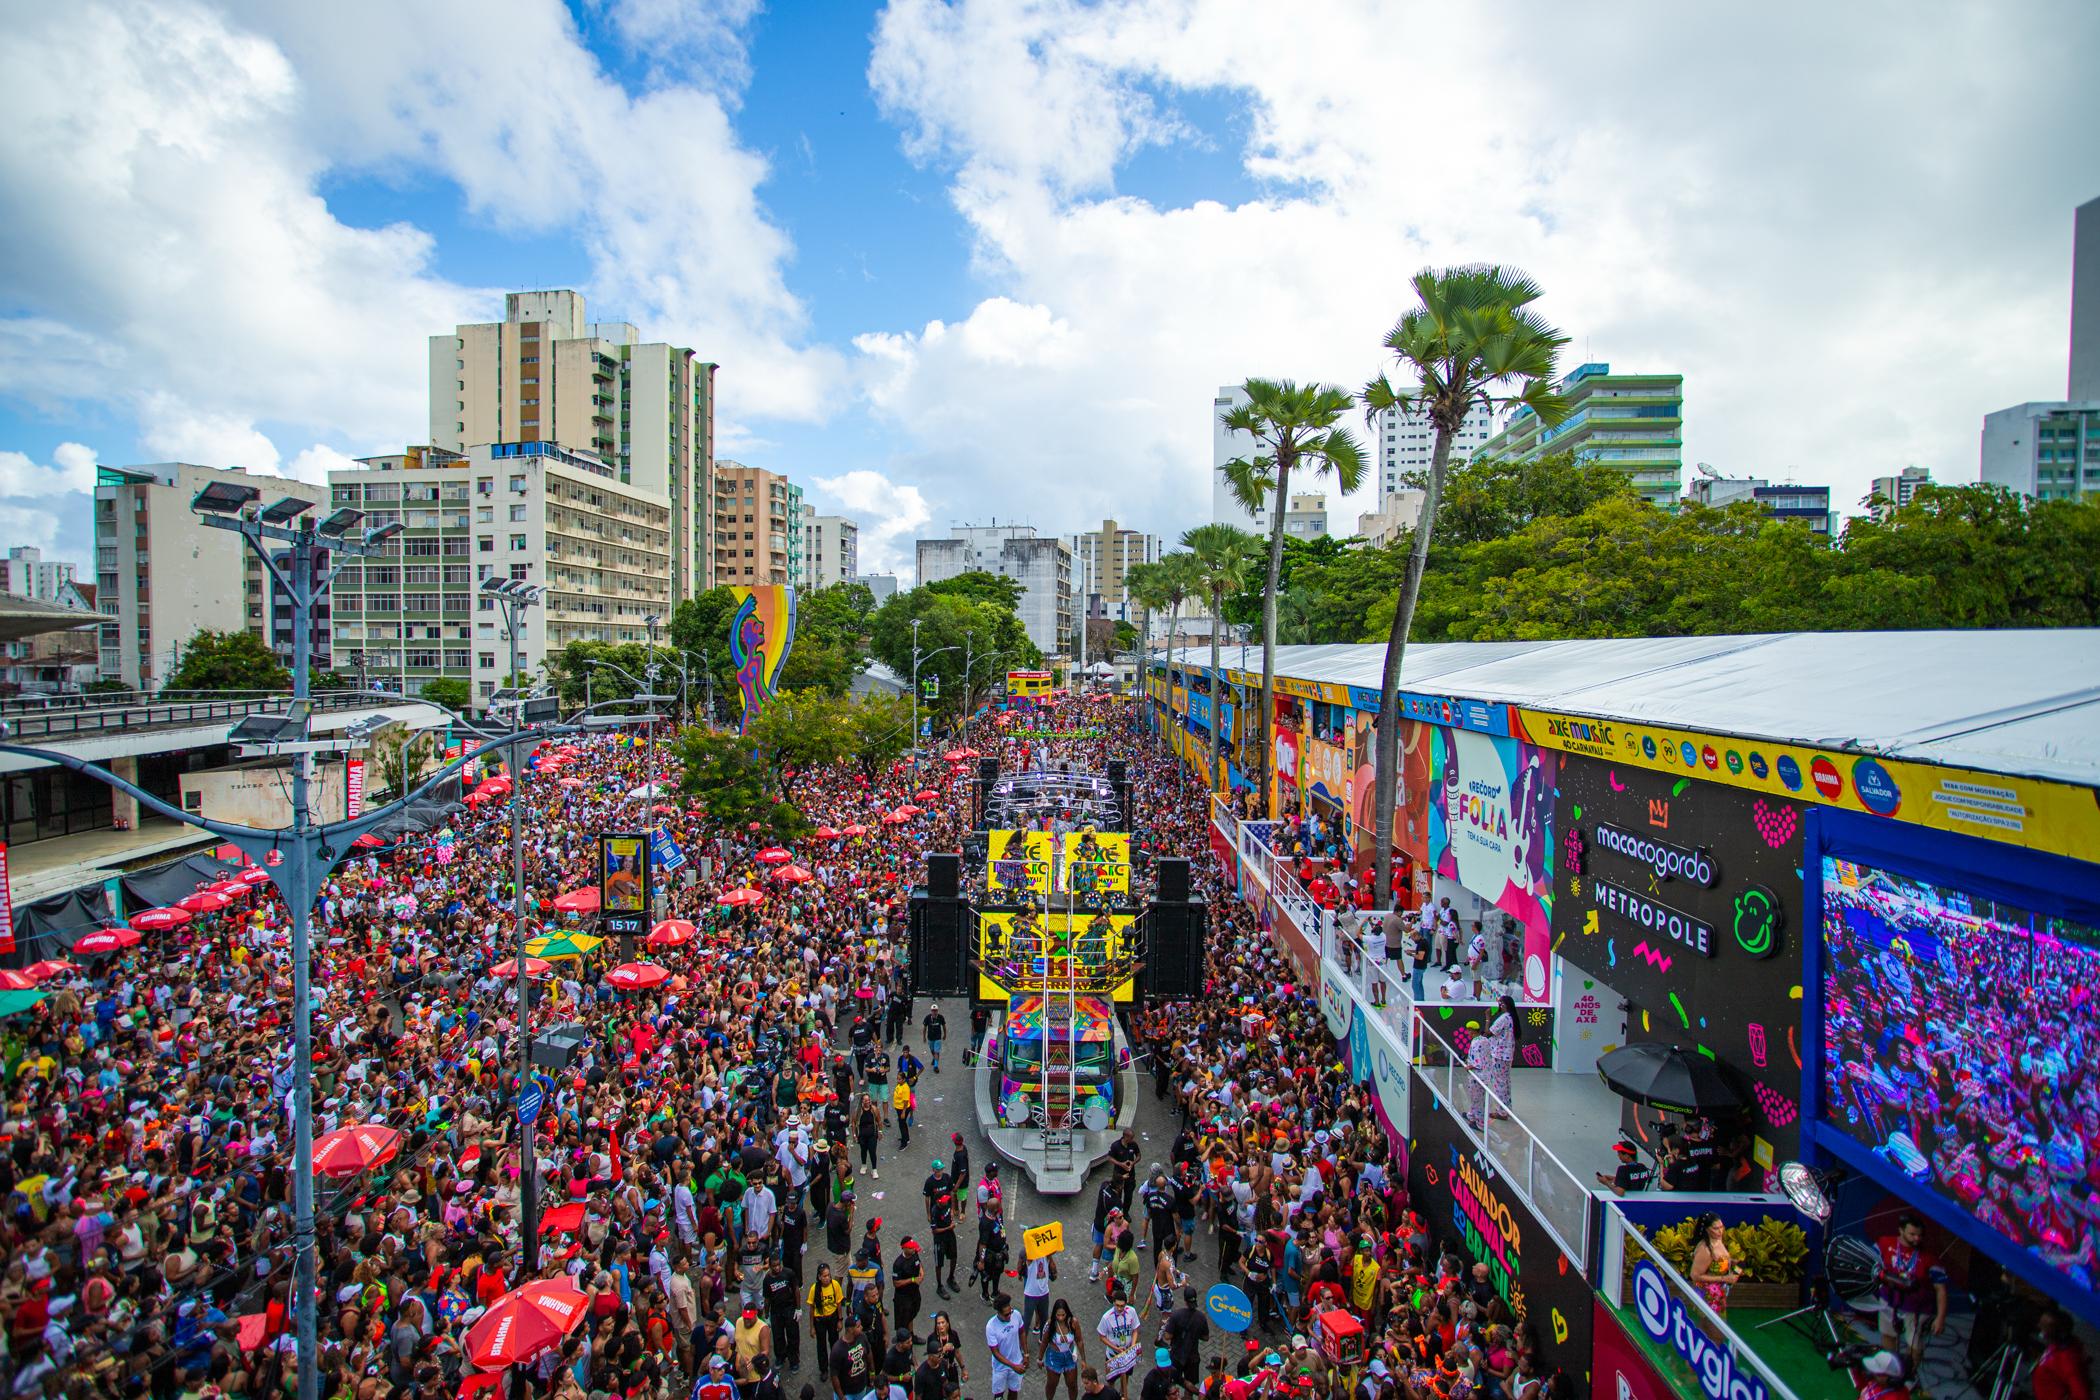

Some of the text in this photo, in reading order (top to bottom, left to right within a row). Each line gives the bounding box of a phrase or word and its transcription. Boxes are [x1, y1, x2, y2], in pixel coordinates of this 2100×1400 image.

[1814, 771, 1839, 785] BRAHMA
[1960, 783, 1973, 792] COM
[348, 765, 363, 817] BRAHMA
[1472, 779, 1497, 798] RECORD
[1861, 785, 1893, 799] SALVADOR
[1460, 792, 1508, 841] FOLIA
[1568, 849, 1577, 861] DE
[1597, 826, 1710, 884] macacogordo
[141, 913, 171, 923] BRAHMA
[1595, 882, 1707, 953] METROPOLE
[83, 935, 115, 946] BRAHMA
[1573, 1001, 1601, 1009] ANOS
[1459, 1153, 1521, 1256] SALVADOR
[1449, 1168, 1513, 1276] CARNAVAL
[1035, 1229, 1057, 1247] PAZ
[538, 1295, 574, 1316] BRAHMA
[490, 1315, 514, 1357] BRAHMA
